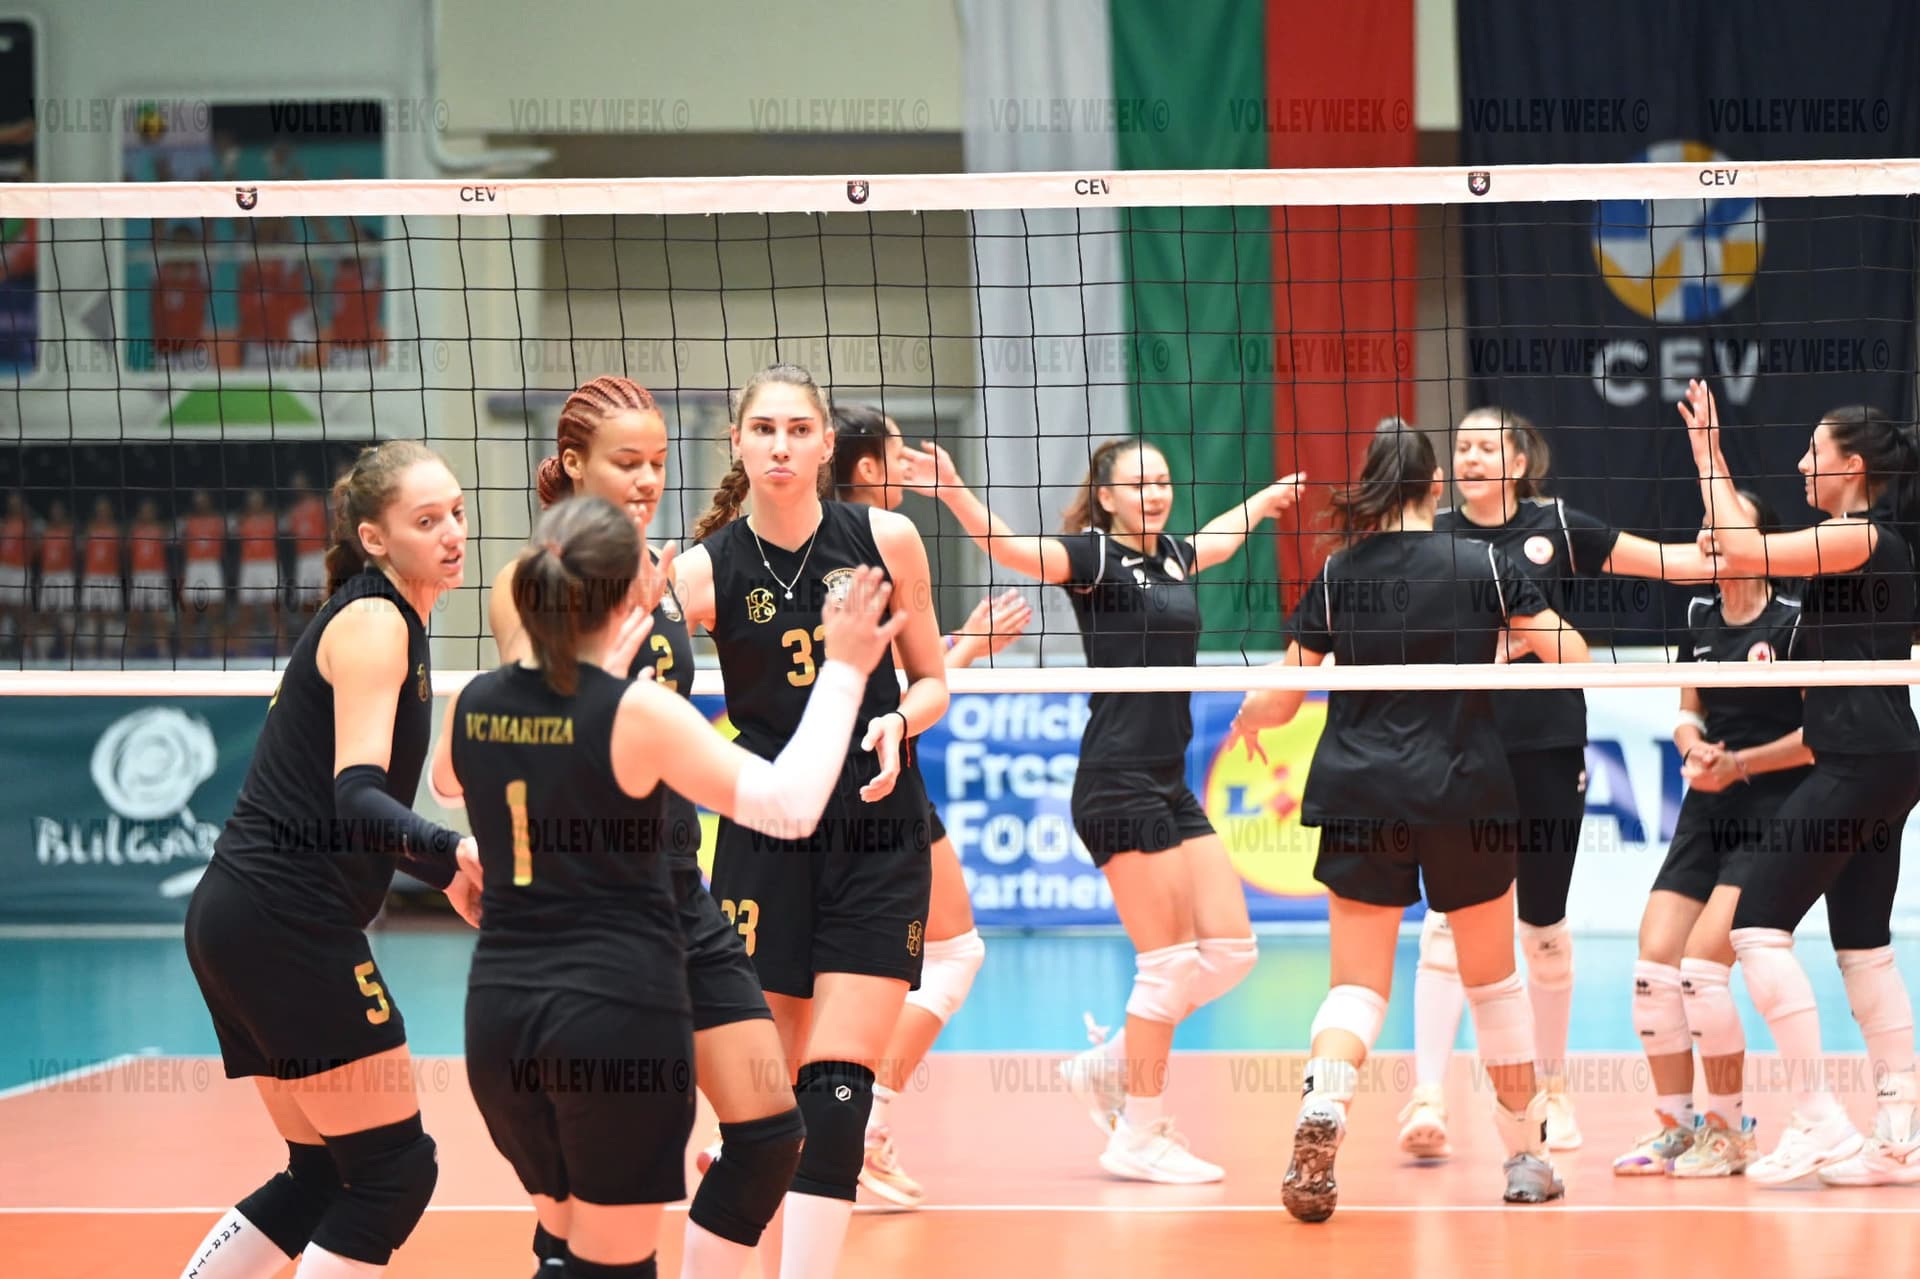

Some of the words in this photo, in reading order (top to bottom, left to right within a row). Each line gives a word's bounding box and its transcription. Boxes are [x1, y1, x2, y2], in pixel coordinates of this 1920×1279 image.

[1074, 177, 1110, 195] CEV
[1699, 169, 1739, 186] CEV
[460, 185, 497, 202] CEV
[1592, 338, 1758, 406] CEV
[465, 713, 488, 741] VC
[489, 714, 575, 744] MARITZA
[505, 779, 533, 887] 1
[353, 960, 391, 1025] 5
